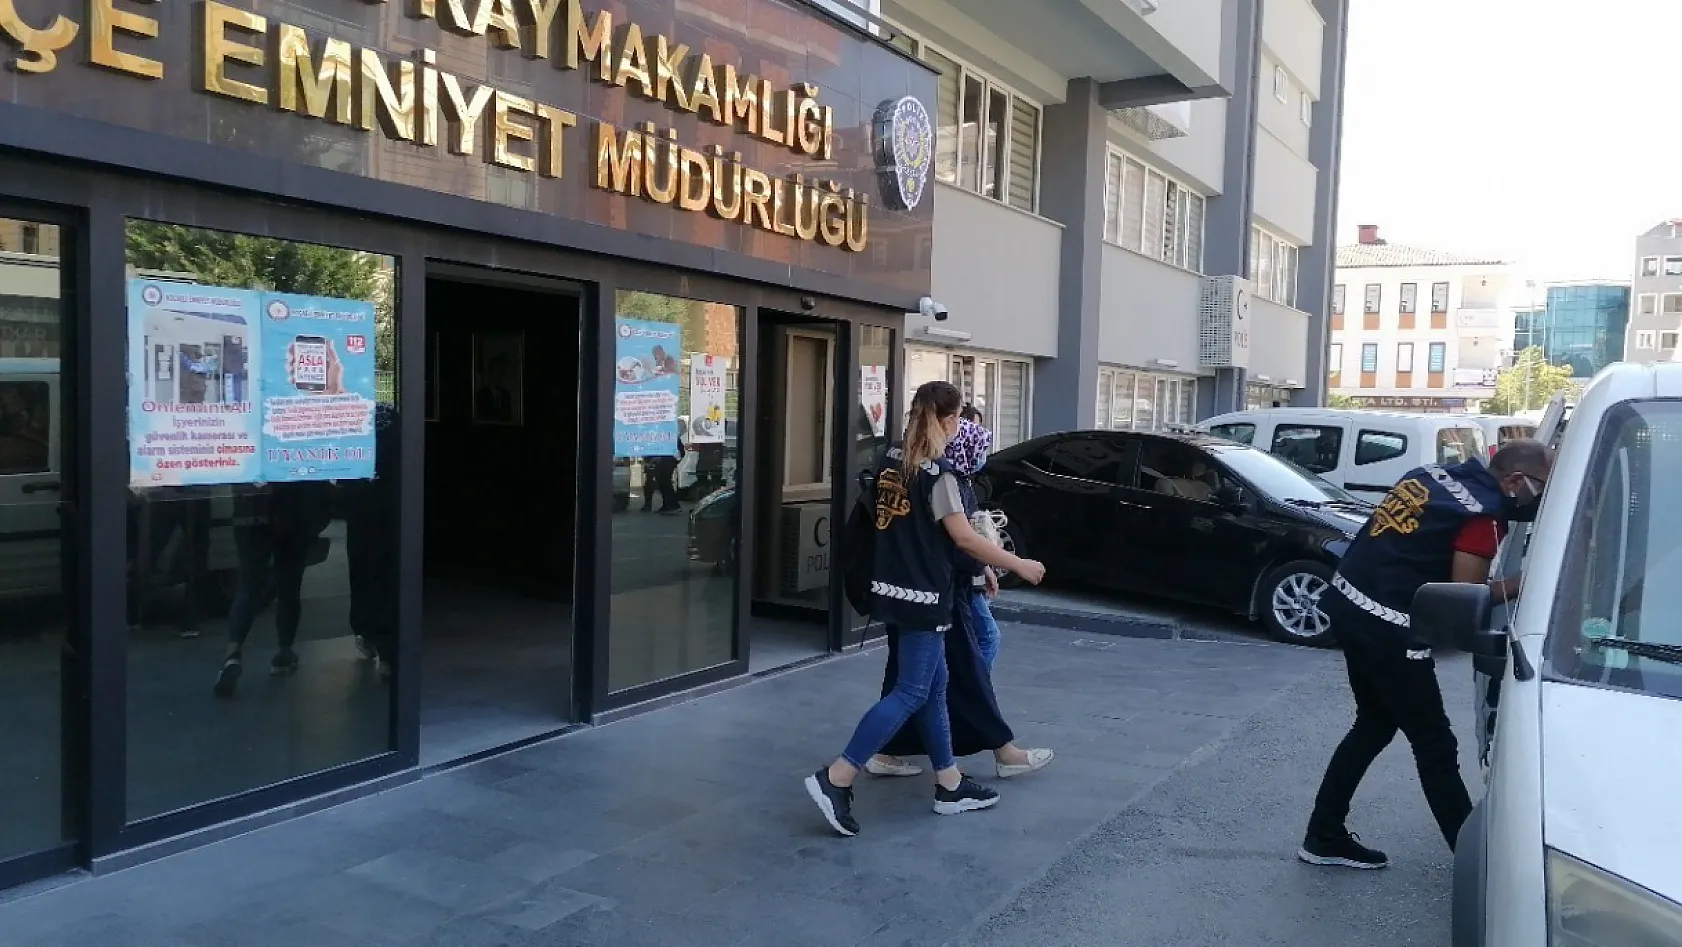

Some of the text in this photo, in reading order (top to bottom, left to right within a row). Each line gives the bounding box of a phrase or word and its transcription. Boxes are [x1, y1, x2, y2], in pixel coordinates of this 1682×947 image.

[202, 1, 577, 179] EMNİYET
[594, 120, 869, 253] MÜDÜRLÜĞÜ
[349, 336, 363, 346] 112
[299, 354, 323, 366] ASLA
[145, 430, 248, 443] güvenlik kamerası ve
[155, 457, 182, 469] özen
